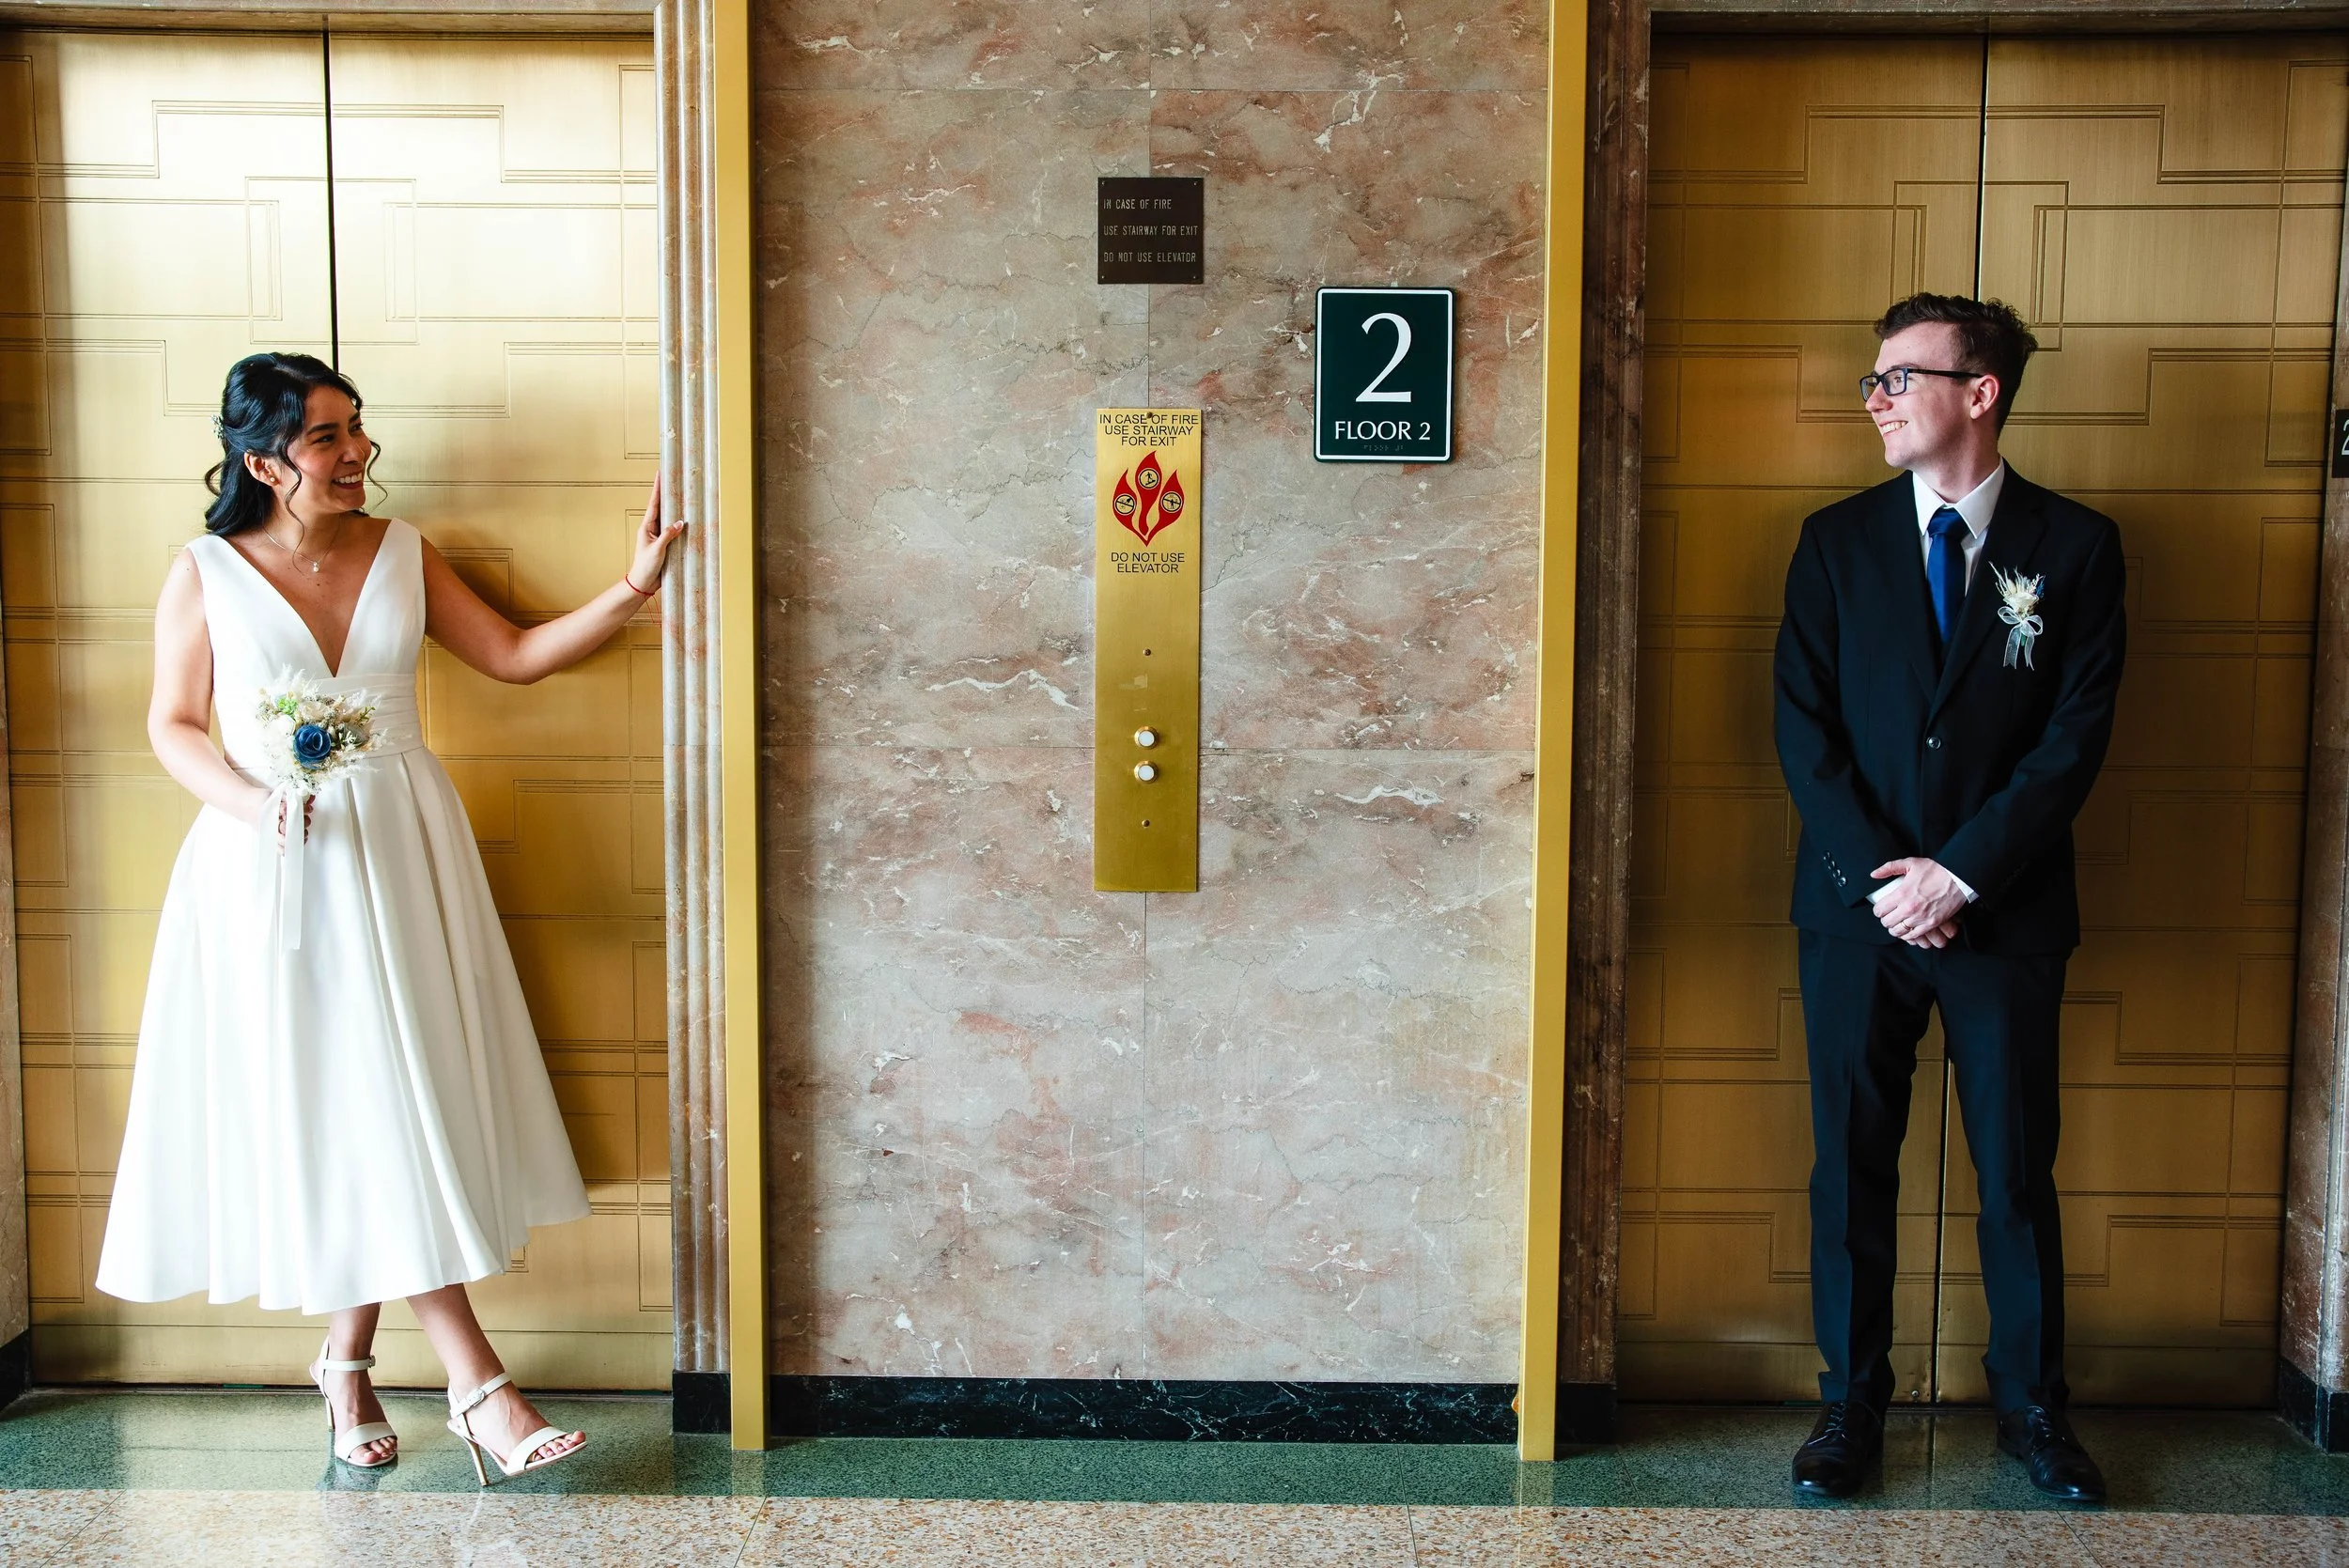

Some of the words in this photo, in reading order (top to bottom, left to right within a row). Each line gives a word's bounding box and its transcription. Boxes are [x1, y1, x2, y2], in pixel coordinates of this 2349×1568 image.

[1104, 199, 1111, 209] IN
[1116, 199, 1135, 209] CASE
[1140, 199, 1149, 209] OF
[1154, 199, 1172, 209] FIRE
[1104, 225, 1117, 236] USE
[1123, 225, 1158, 236] STAIRWAY
[1162, 225, 1175, 236] FOR
[1181, 225, 1197, 236] EXIT
[1104, 252, 1113, 262] DO
[1118, 252, 1132, 262] NOT
[1138, 252, 1152, 262] USE
[1158, 252, 1196, 262] ELEVATOR
[1356, 313, 1411, 402] 2
[1099, 414, 1112, 424] IN
[1115, 414, 1147, 424] CASE
[1151, 414, 1168, 425] OF
[1172, 414, 1199, 425] FIRE
[1105, 426, 1128, 435] USE
[1133, 426, 1193, 435] STAIRWAY
[1335, 421, 1411, 440] FLOOR
[1419, 422, 1430, 440] 2
[1121, 437, 1146, 446] FOR
[1151, 437, 1176, 446] EXIT
[1112, 552, 1128, 563] DO
[1133, 552, 1158, 563] NOT
[1161, 552, 1185, 563] USE
[1117, 564, 1178, 573] ELEVATOR
